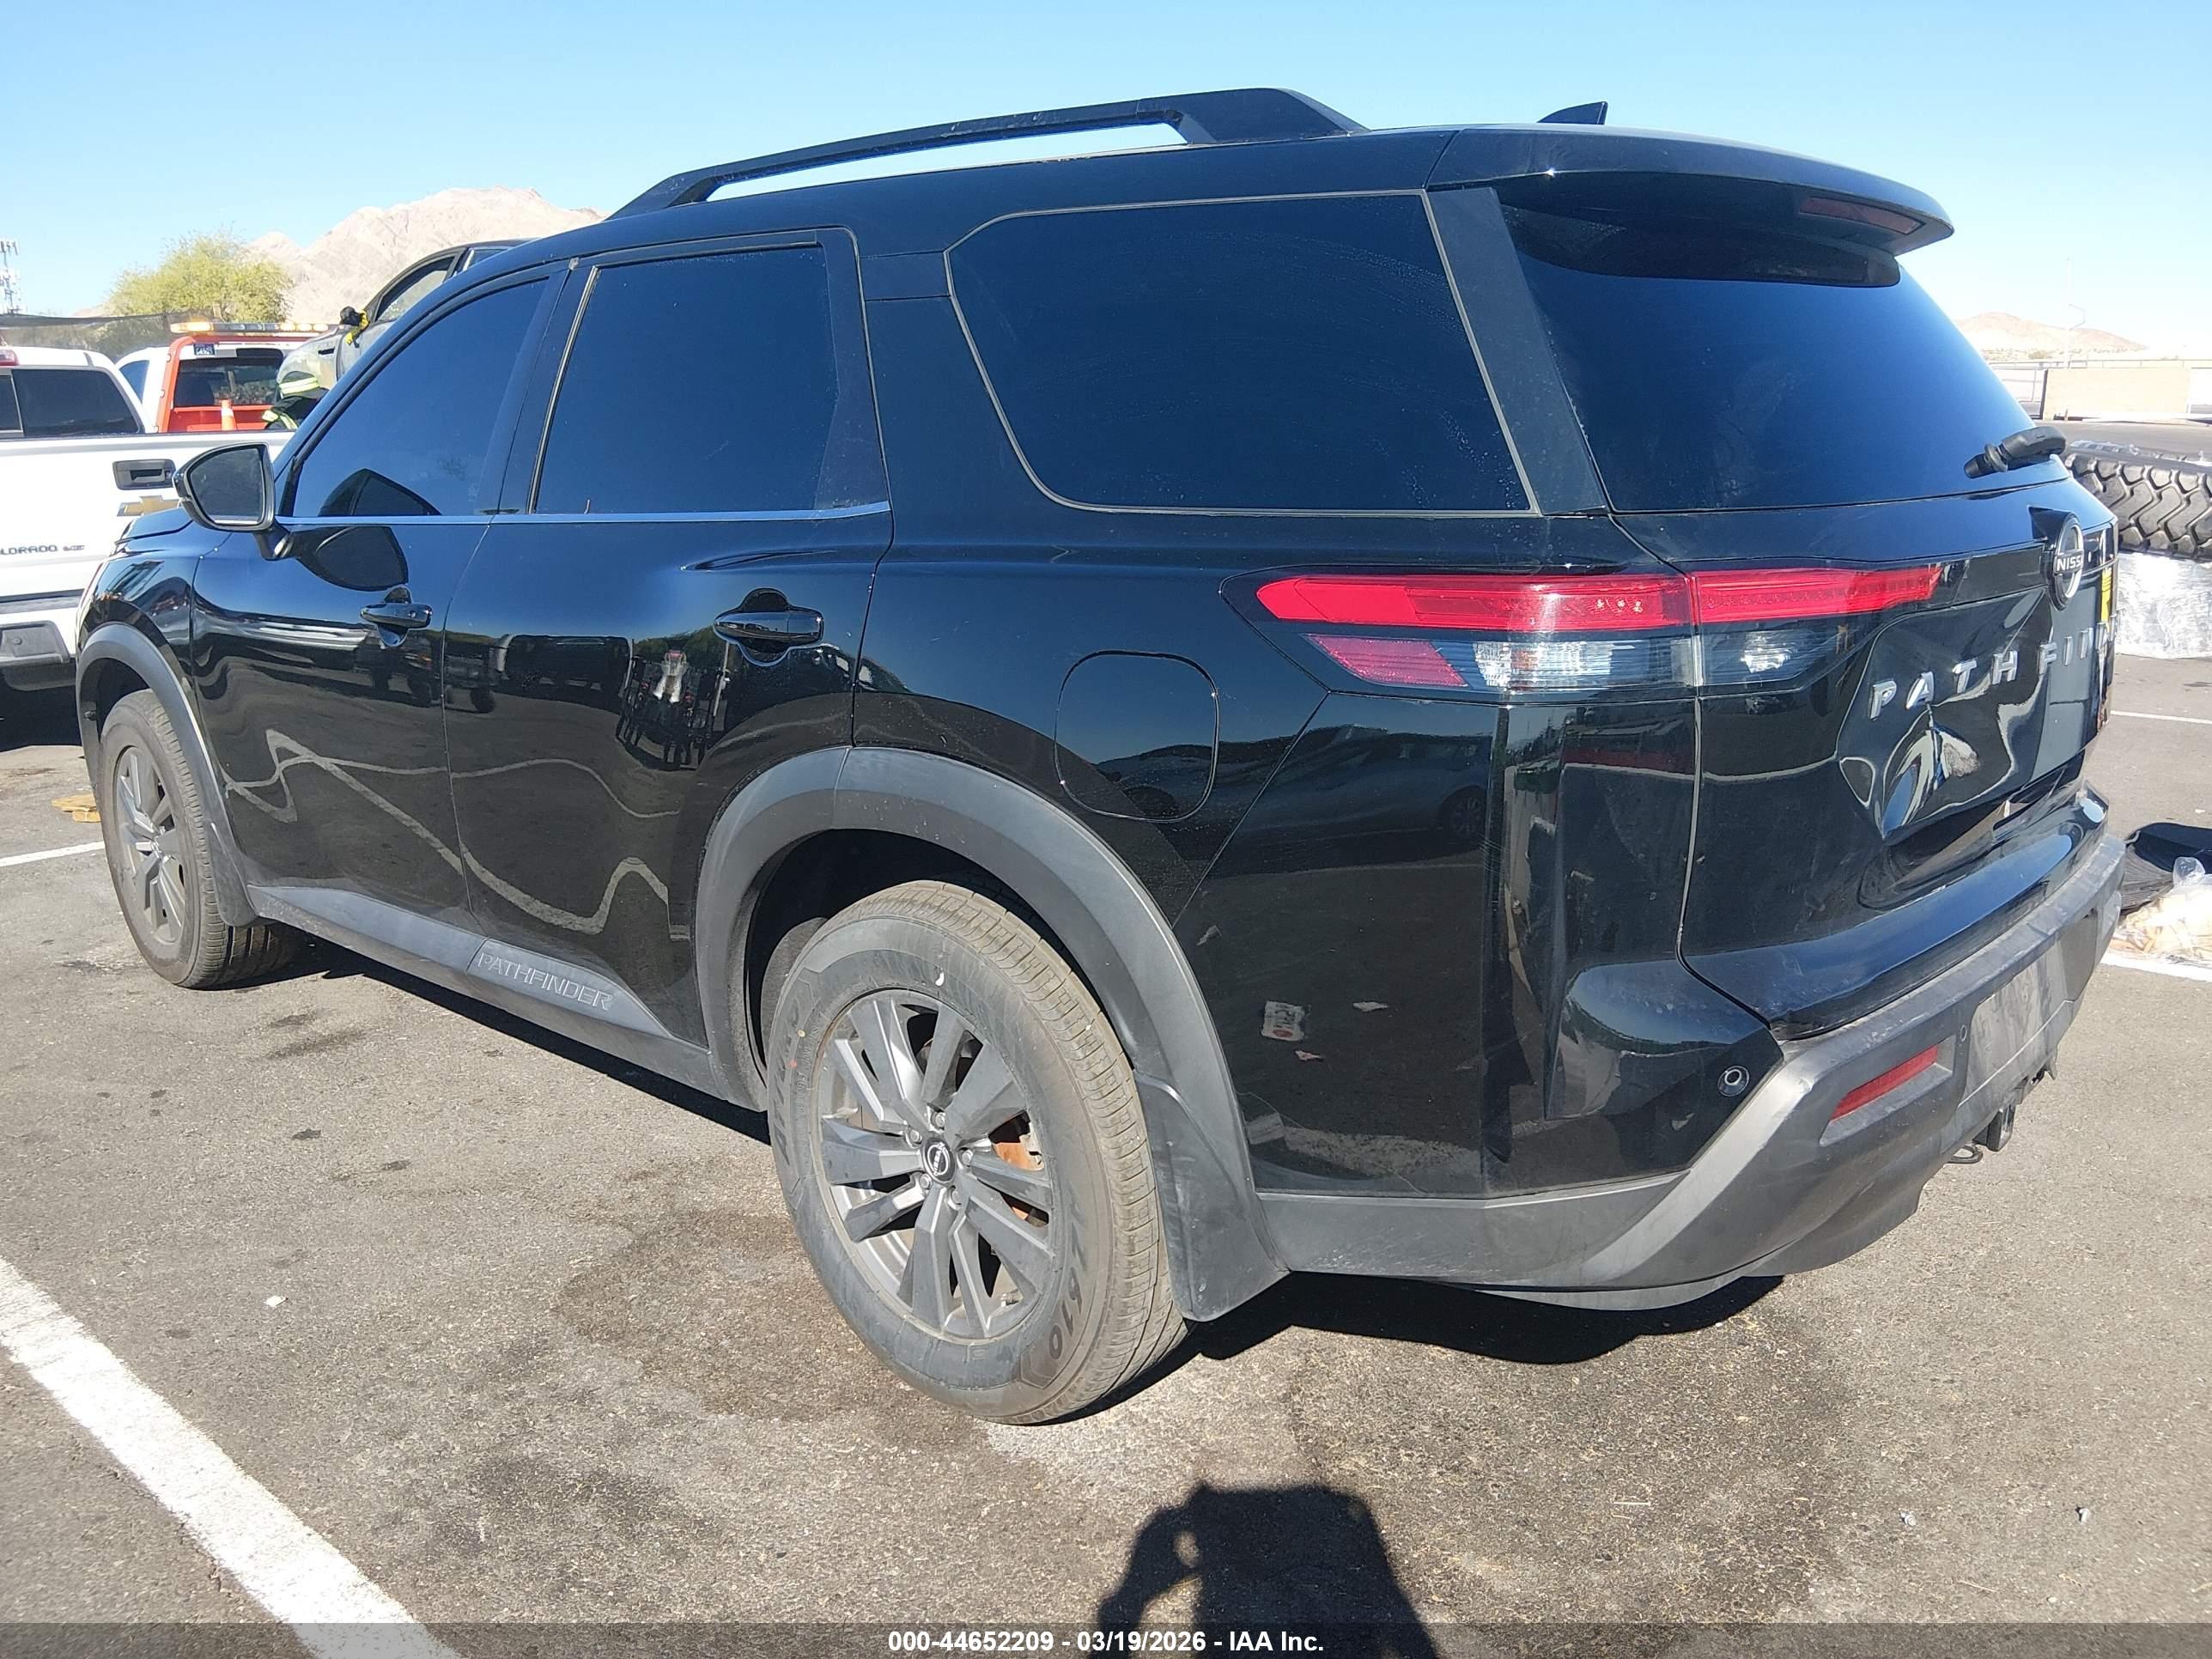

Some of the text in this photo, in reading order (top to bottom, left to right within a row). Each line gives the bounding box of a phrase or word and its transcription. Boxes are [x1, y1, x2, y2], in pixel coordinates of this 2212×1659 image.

[0, 544, 58, 555] LORADO
[2056, 555, 2081, 572] NISS
[477, 952, 613, 1011] PATHFINDER
